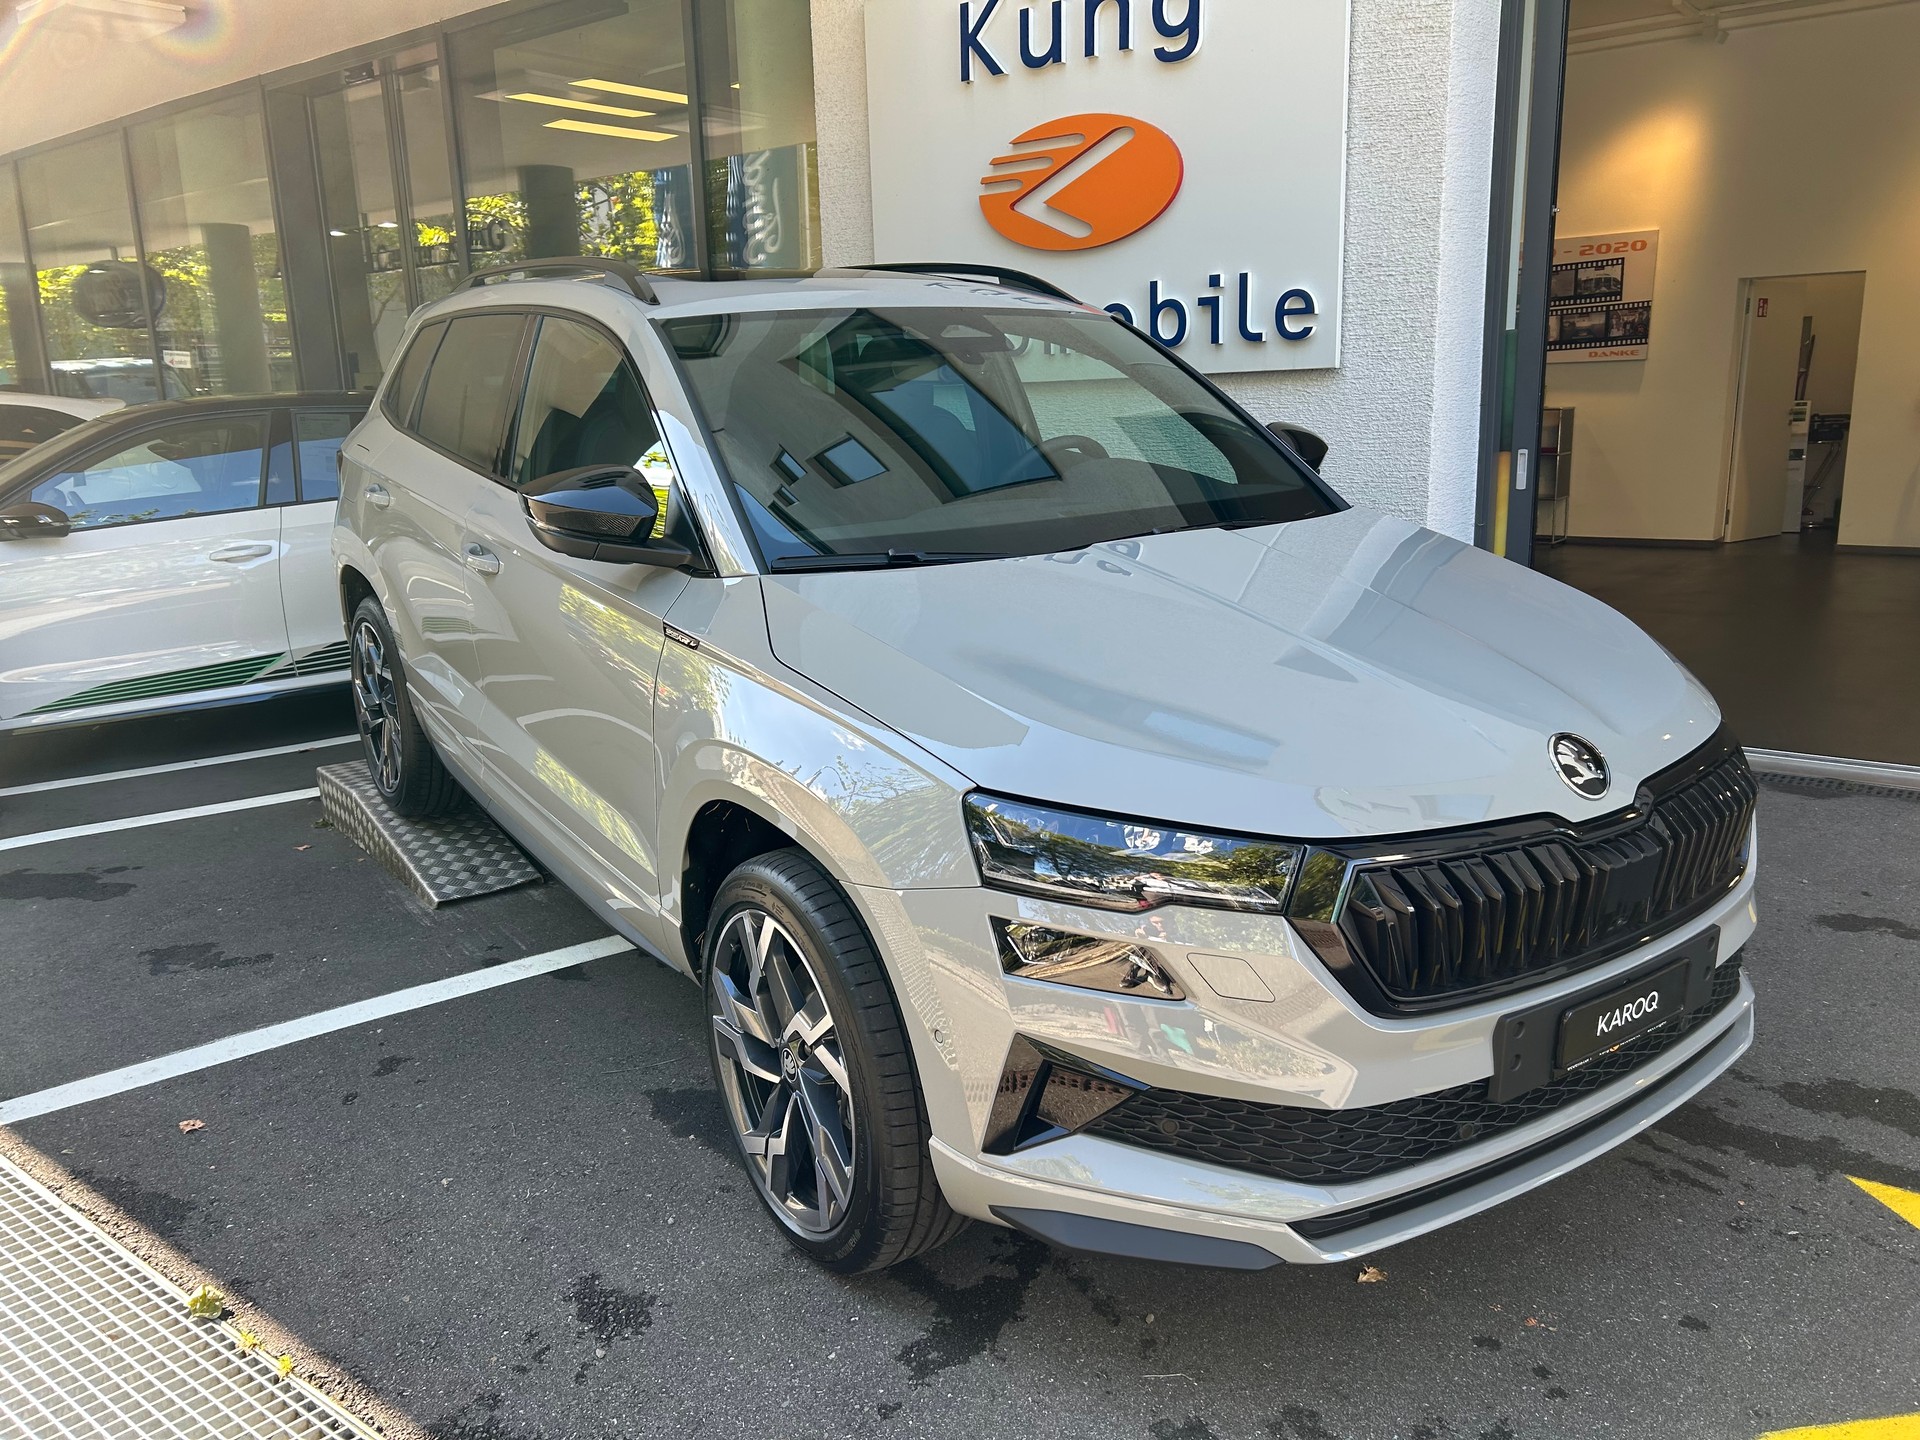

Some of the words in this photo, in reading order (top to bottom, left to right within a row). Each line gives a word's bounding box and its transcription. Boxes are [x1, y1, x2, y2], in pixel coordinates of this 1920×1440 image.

[1579, 240, 1647, 256] 2020
[1588, 349, 1639, 358] DANKE
[1597, 991, 1659, 1036] KAROQ
